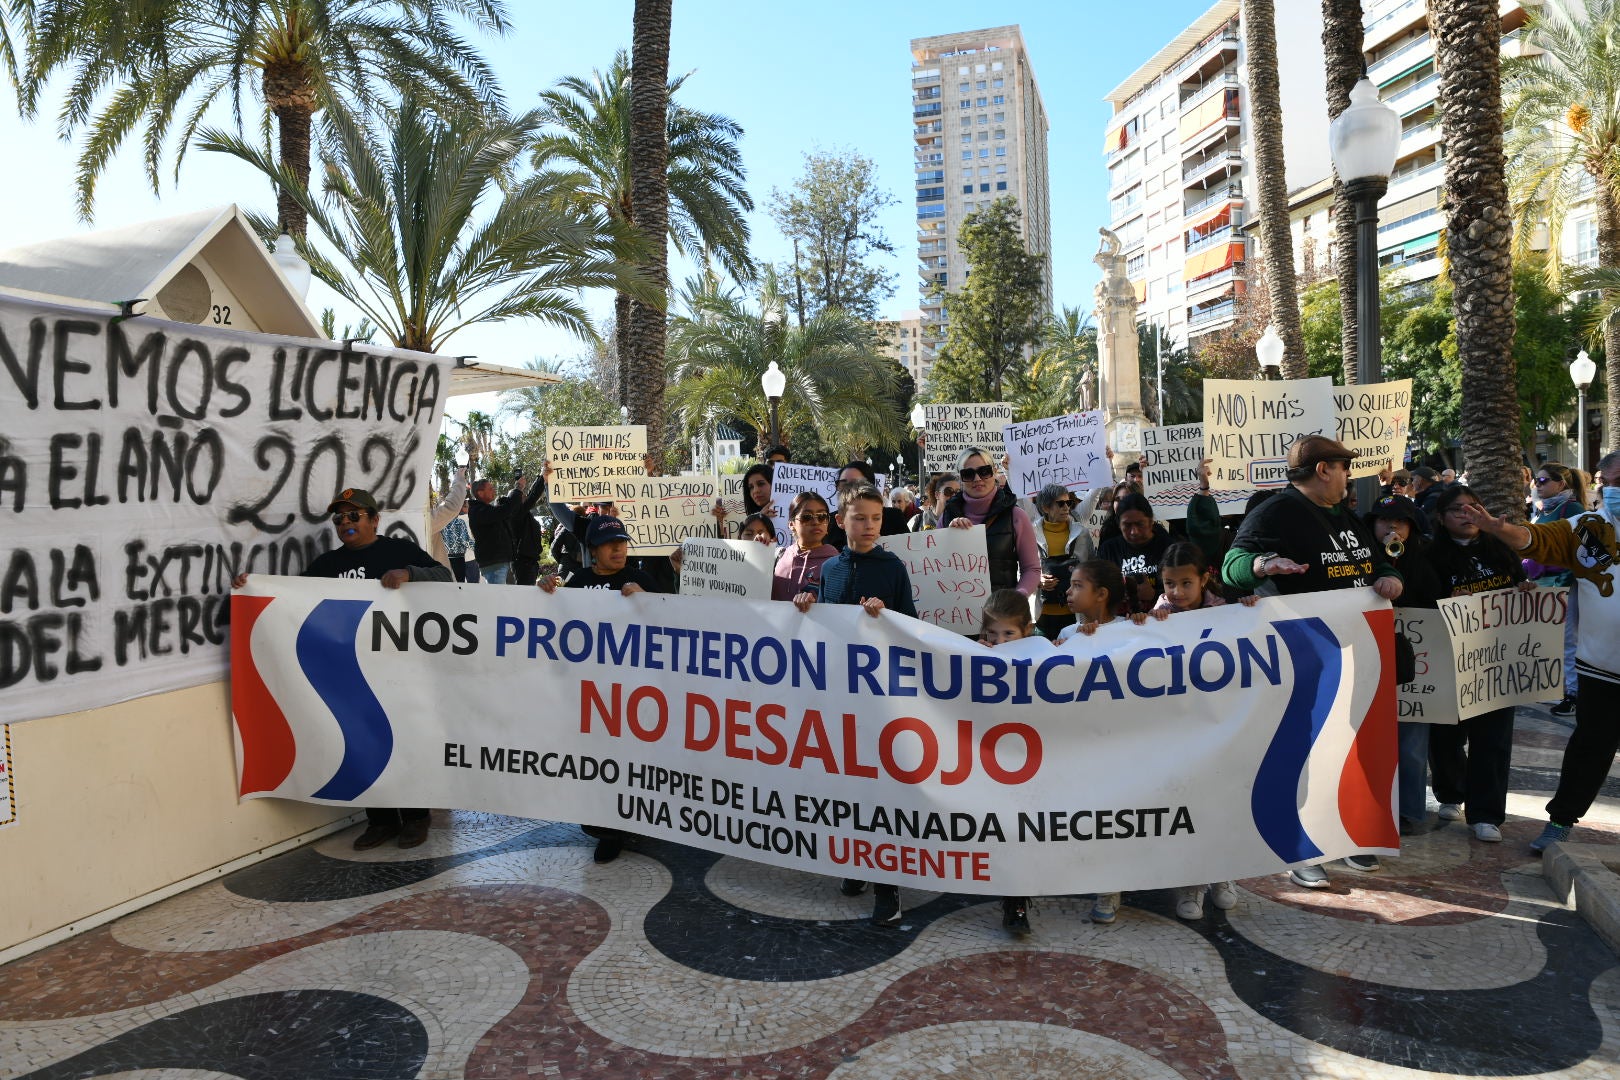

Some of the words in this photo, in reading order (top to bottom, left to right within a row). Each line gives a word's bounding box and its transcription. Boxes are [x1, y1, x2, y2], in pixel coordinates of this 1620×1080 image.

[213, 305, 231, 325] 32
[925, 406, 937, 419] EL
[938, 406, 951, 420] PP
[954, 406, 972, 420] NOS
[974, 404, 1011, 419] ENGAÑO
[1262, 393, 1305, 420] MÁS
[1333, 393, 1354, 412] NO
[1359, 390, 1409, 413] QUIERO
[925, 421, 930, 431] A
[931, 420, 969, 431] NOSOTROS
[1005, 423, 1054, 441] TENEMOS
[1052, 415, 1099, 431] FAMILIAS
[552, 430, 573, 451] 60
[578, 431, 632, 449] FAMILIAS
[926, 433, 973, 443] DIFERENTES
[1020, 441, 1034, 456] NO
[1038, 438, 1060, 454] NOS
[1060, 432, 1096, 449] DEJEN
[1143, 430, 1160, 446] EL
[553, 454, 559, 462] A
[561, 453, 570, 462] LA
[573, 452, 595, 462] CALLE
[602, 453, 613, 461] NO
[615, 452, 637, 461] PUEDE
[1037, 454, 1052, 467] EN
[1055, 453, 1068, 464] LA
[1145, 446, 1204, 467] DERECH
[50, 433, 109, 511] EL
[118, 413, 225, 506] AÑO
[228, 432, 420, 534] 2026
[553, 466, 600, 480] TENEMOS
[602, 465, 645, 477] DERECHO
[777, 465, 836, 483] QUEREMOS
[1217, 468, 1223, 480] A
[1228, 468, 1244, 481] LOS
[615, 483, 636, 499] NO
[641, 483, 657, 499] AL
[659, 482, 714, 498] DESALOJO
[621, 504, 637, 519] SI
[641, 504, 651, 520] A
[655, 504, 670, 519] LA
[624, 518, 717, 546] REUBICACIÓN
[683, 543, 704, 558] PARA
[706, 546, 728, 560] TODO
[730, 549, 746, 562] HAY
[0, 549, 39, 614] A
[50, 543, 99, 607] LA
[682, 574, 690, 586] SI
[691, 576, 706, 589] HAY
[709, 579, 747, 597] VOLUNTAD
[1441, 602, 1480, 637] Mis
[1481, 590, 1569, 630] ESTUDIOS
[373, 611, 478, 655] NOS
[497, 616, 826, 690] PROMETIERON
[848, 628, 1282, 705] REUBICACIÓN
[1457, 637, 1507, 674] depende
[1518, 632, 1542, 658] de
[1401, 684, 1419, 694] DE
[1422, 684, 1436, 695] LA
[1460, 673, 1484, 709] este
[1483, 657, 1562, 702] TRABAJO
[581, 681, 667, 742] NO
[686, 694, 1042, 785] DESALOJO
[445, 743, 472, 769] EL
[480, 747, 620, 784] MERCADO
[628, 763, 704, 801] HIPPIE
[712, 779, 744, 811] DE
[752, 787, 786, 819] LA
[795, 795, 1006, 842] EXPLANADA
[1018, 806, 1195, 842] NECESITA
[618, 794, 673, 829] UNA
[680, 807, 818, 860] SOLUCION
[829, 837, 991, 881] URGENTE
